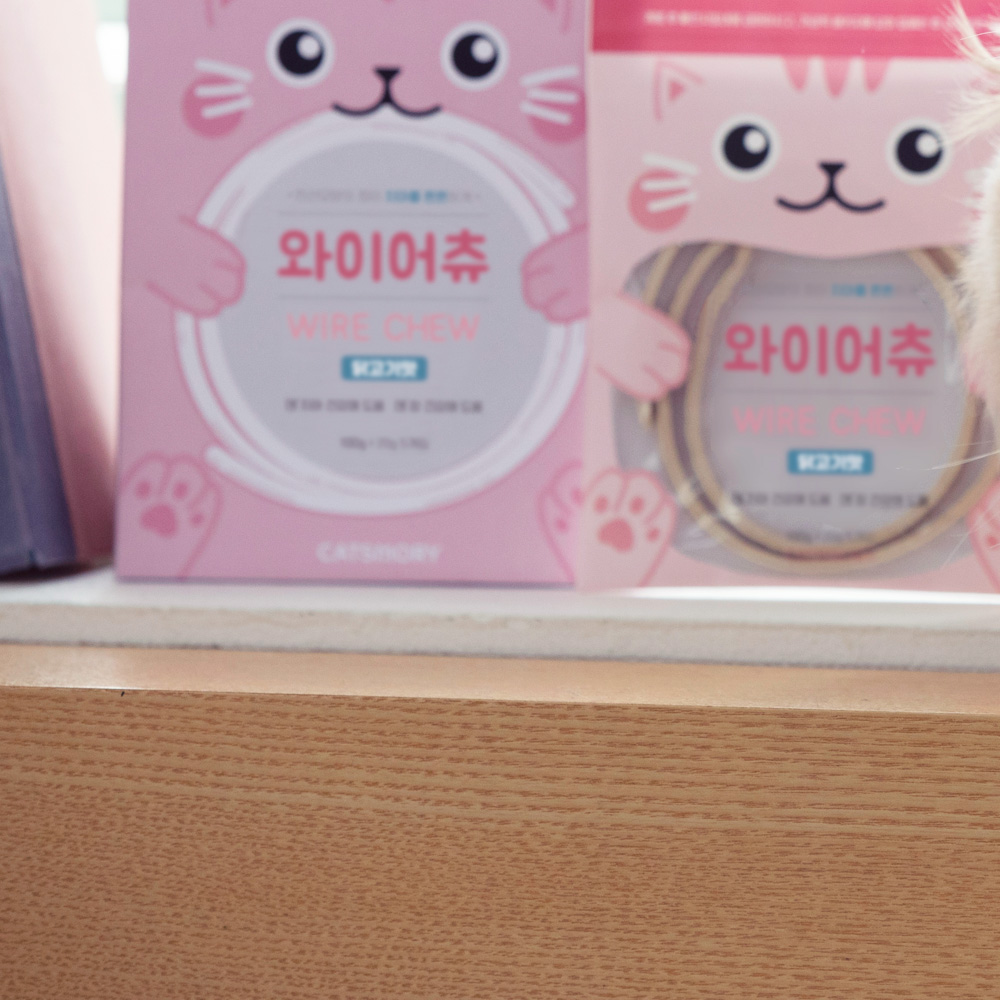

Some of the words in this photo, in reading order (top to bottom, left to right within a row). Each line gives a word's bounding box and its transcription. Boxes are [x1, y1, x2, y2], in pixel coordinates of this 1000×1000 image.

[277, 228, 490, 284] 와이어츄
[286, 312, 371, 342] WIRE
[383, 313, 481, 344] CHEW
[723, 322, 936, 377] 와이어츄
[732, 405, 817, 436] WIRE
[828, 405, 927, 437] CHEW
